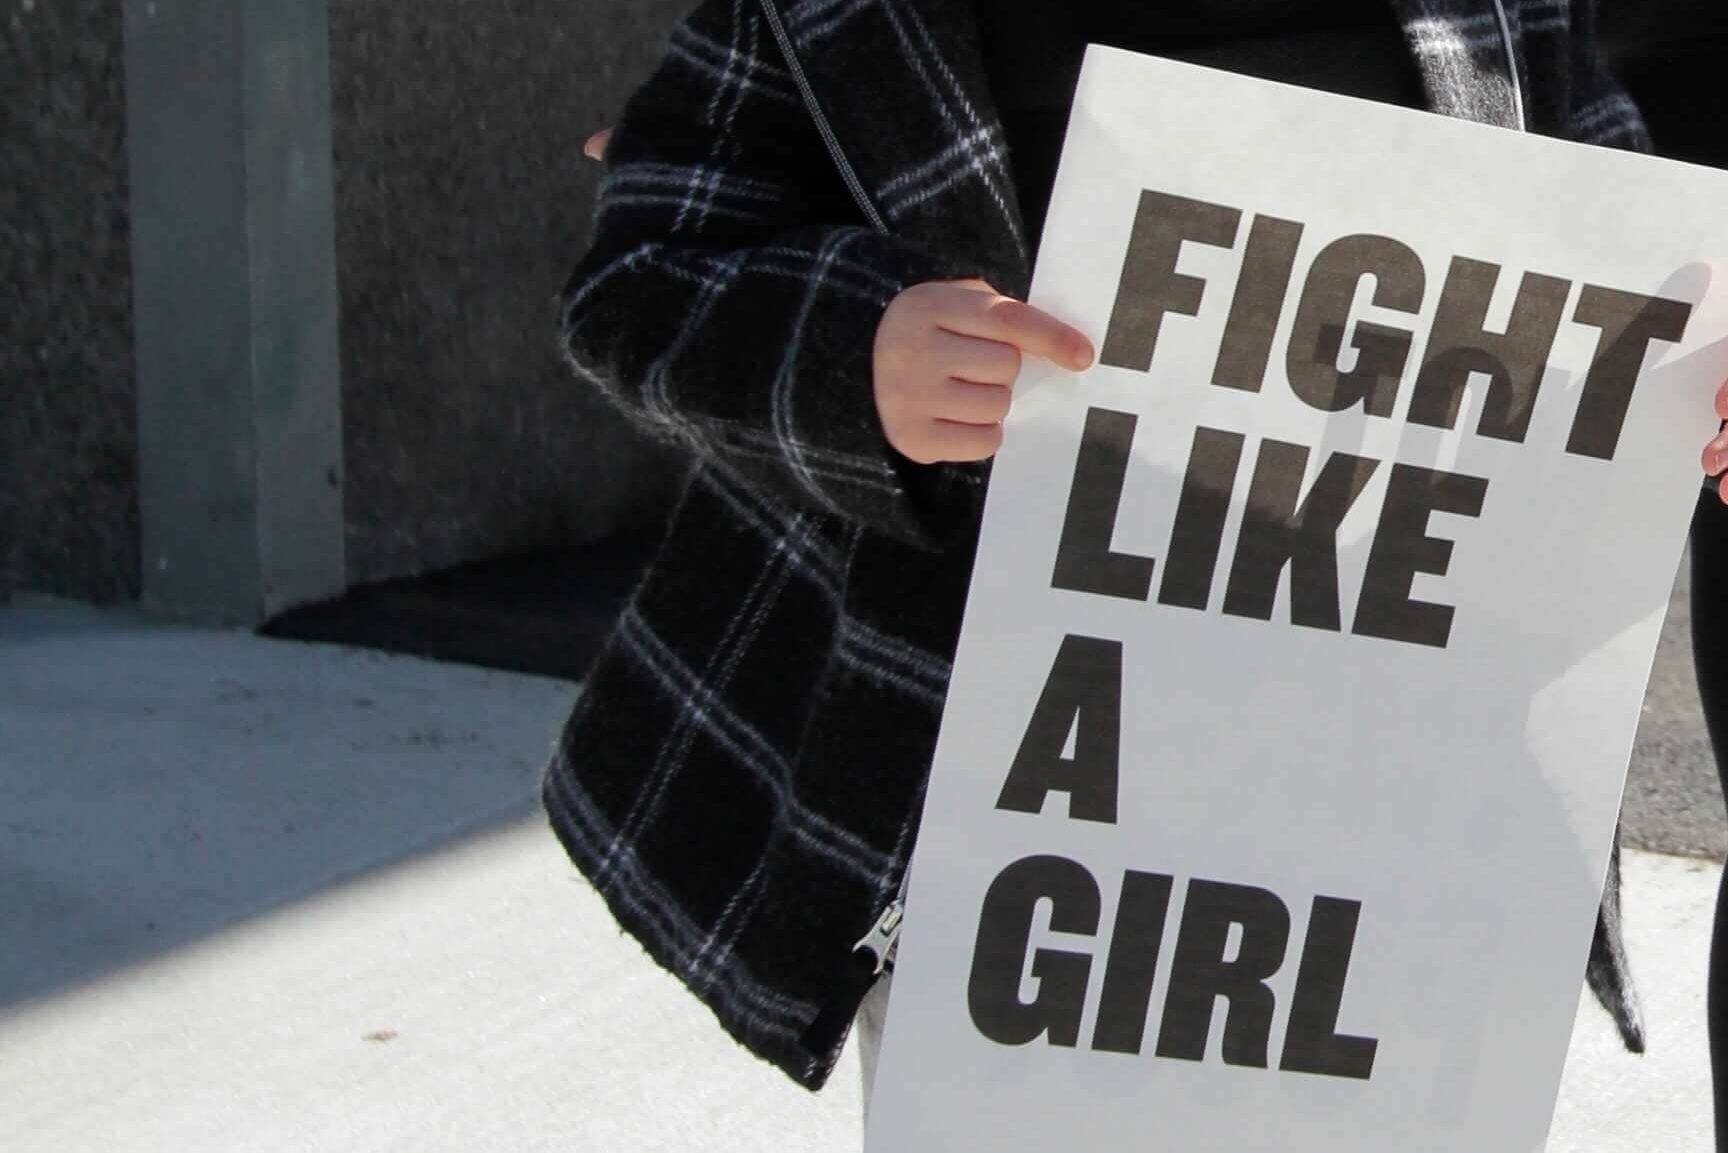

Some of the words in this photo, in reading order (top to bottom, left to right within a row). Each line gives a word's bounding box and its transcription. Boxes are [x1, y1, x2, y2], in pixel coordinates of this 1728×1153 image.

[1099, 189, 1691, 461] FIGHT
[1051, 406, 1489, 648] LIKE
[994, 632, 1124, 825] A
[966, 853, 1380, 1080] GIRL
